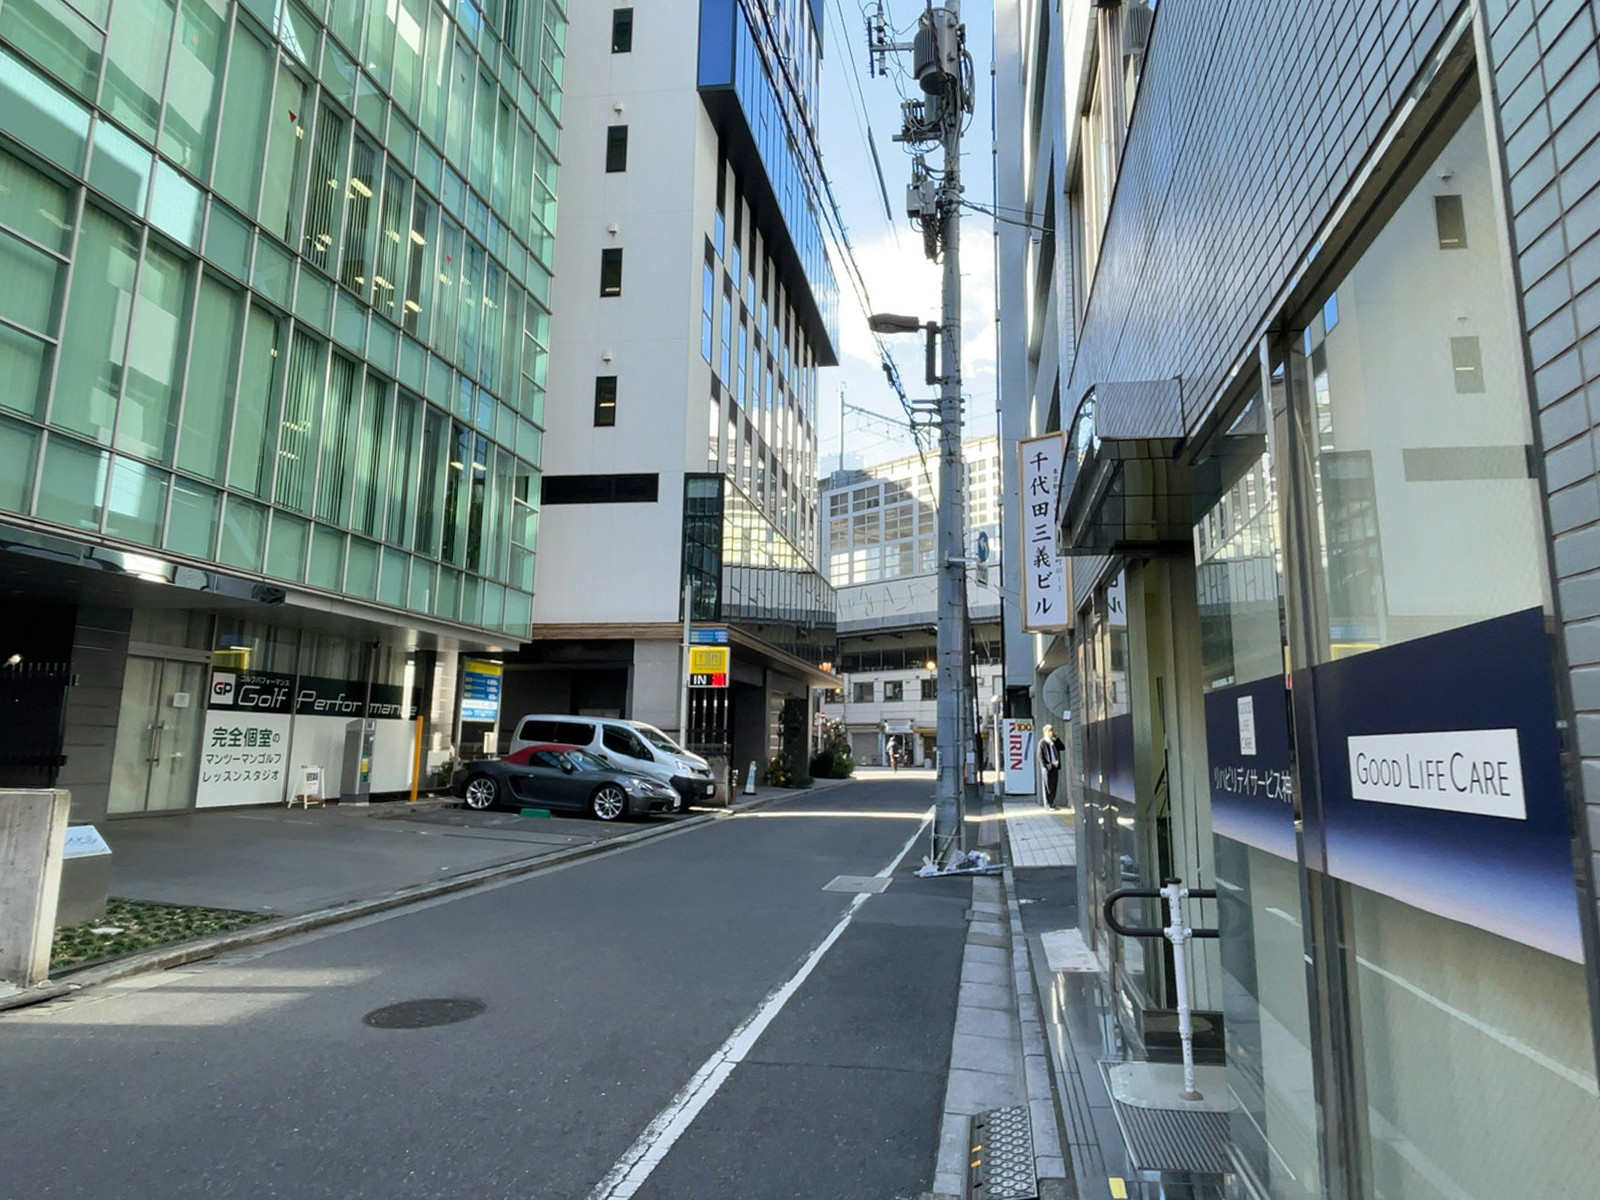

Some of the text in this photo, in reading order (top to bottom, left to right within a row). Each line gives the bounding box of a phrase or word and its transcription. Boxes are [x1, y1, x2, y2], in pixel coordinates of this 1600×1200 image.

[1029, 452, 1054, 615] 千代田三義ビル
[693, 675, 707, 685] IN
[214, 682, 233, 696] GP
[238, 685, 288, 708] Golf
[211, 727, 280, 748] 完全個室の
[206, 753, 282, 765] マンツーマンゴルフ
[203, 770, 279, 783] レッスンスタジオ
[1356, 752, 1511, 797] GOOD LIFE CARE
